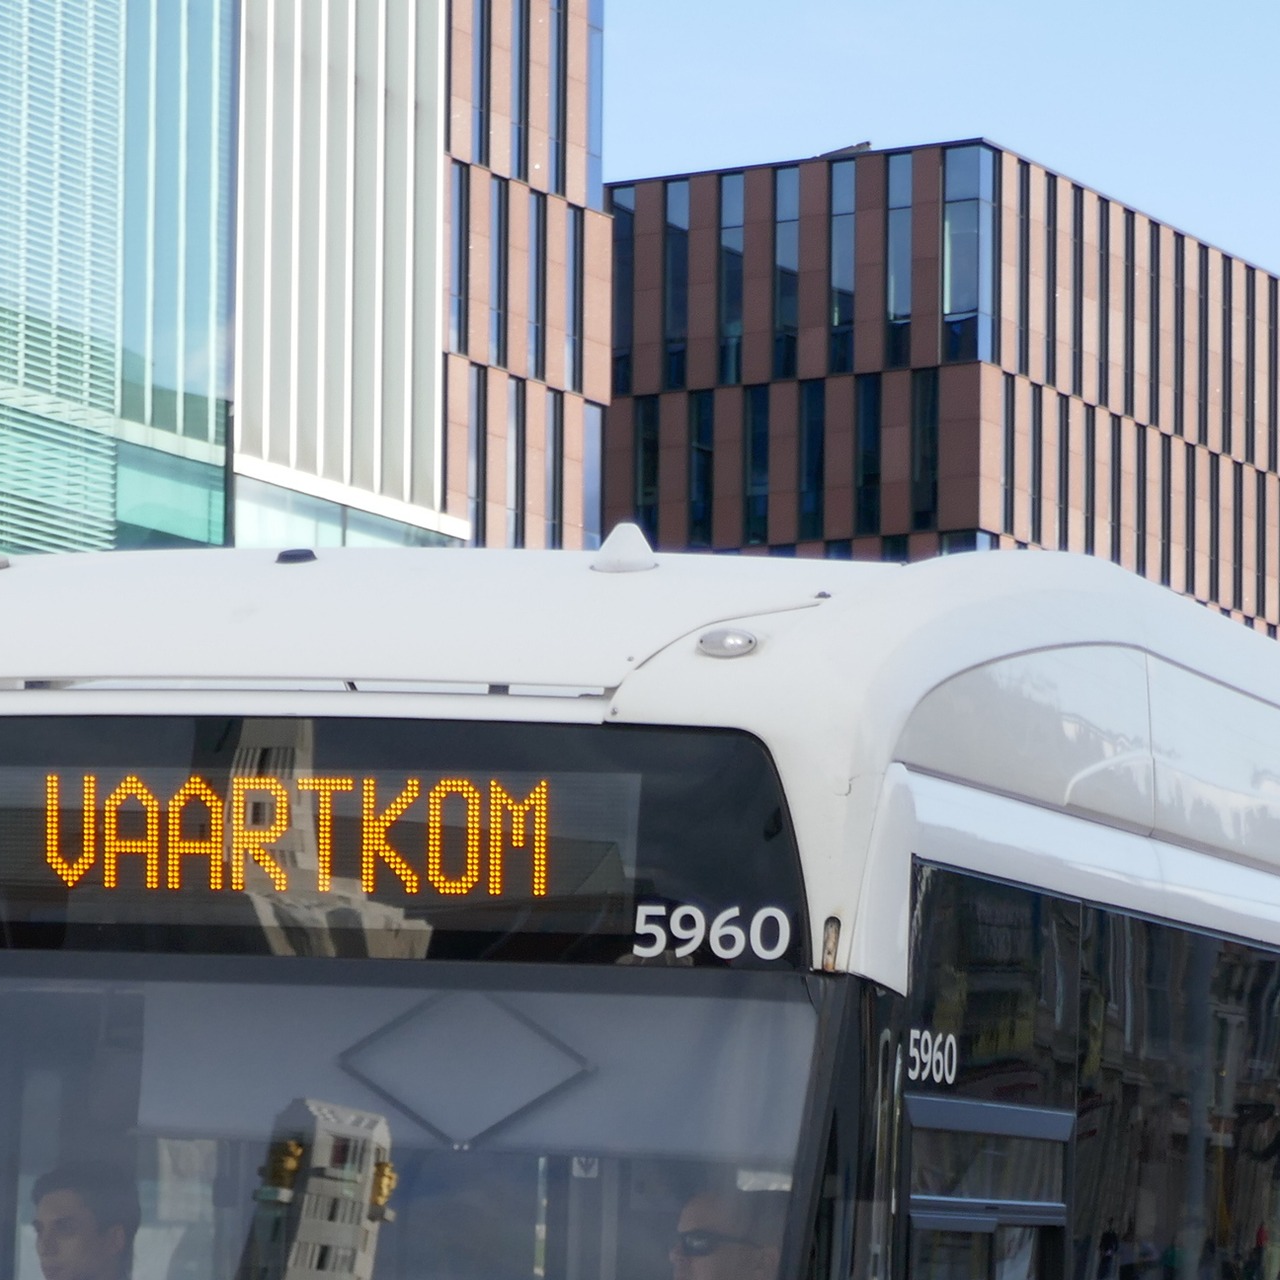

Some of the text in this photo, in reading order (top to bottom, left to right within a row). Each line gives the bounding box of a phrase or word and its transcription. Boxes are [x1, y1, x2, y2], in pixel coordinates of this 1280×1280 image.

[43, 773, 549, 898] VAARTKOM
[633, 907, 790, 962] 5960
[907, 1029, 957, 1084] 5960
